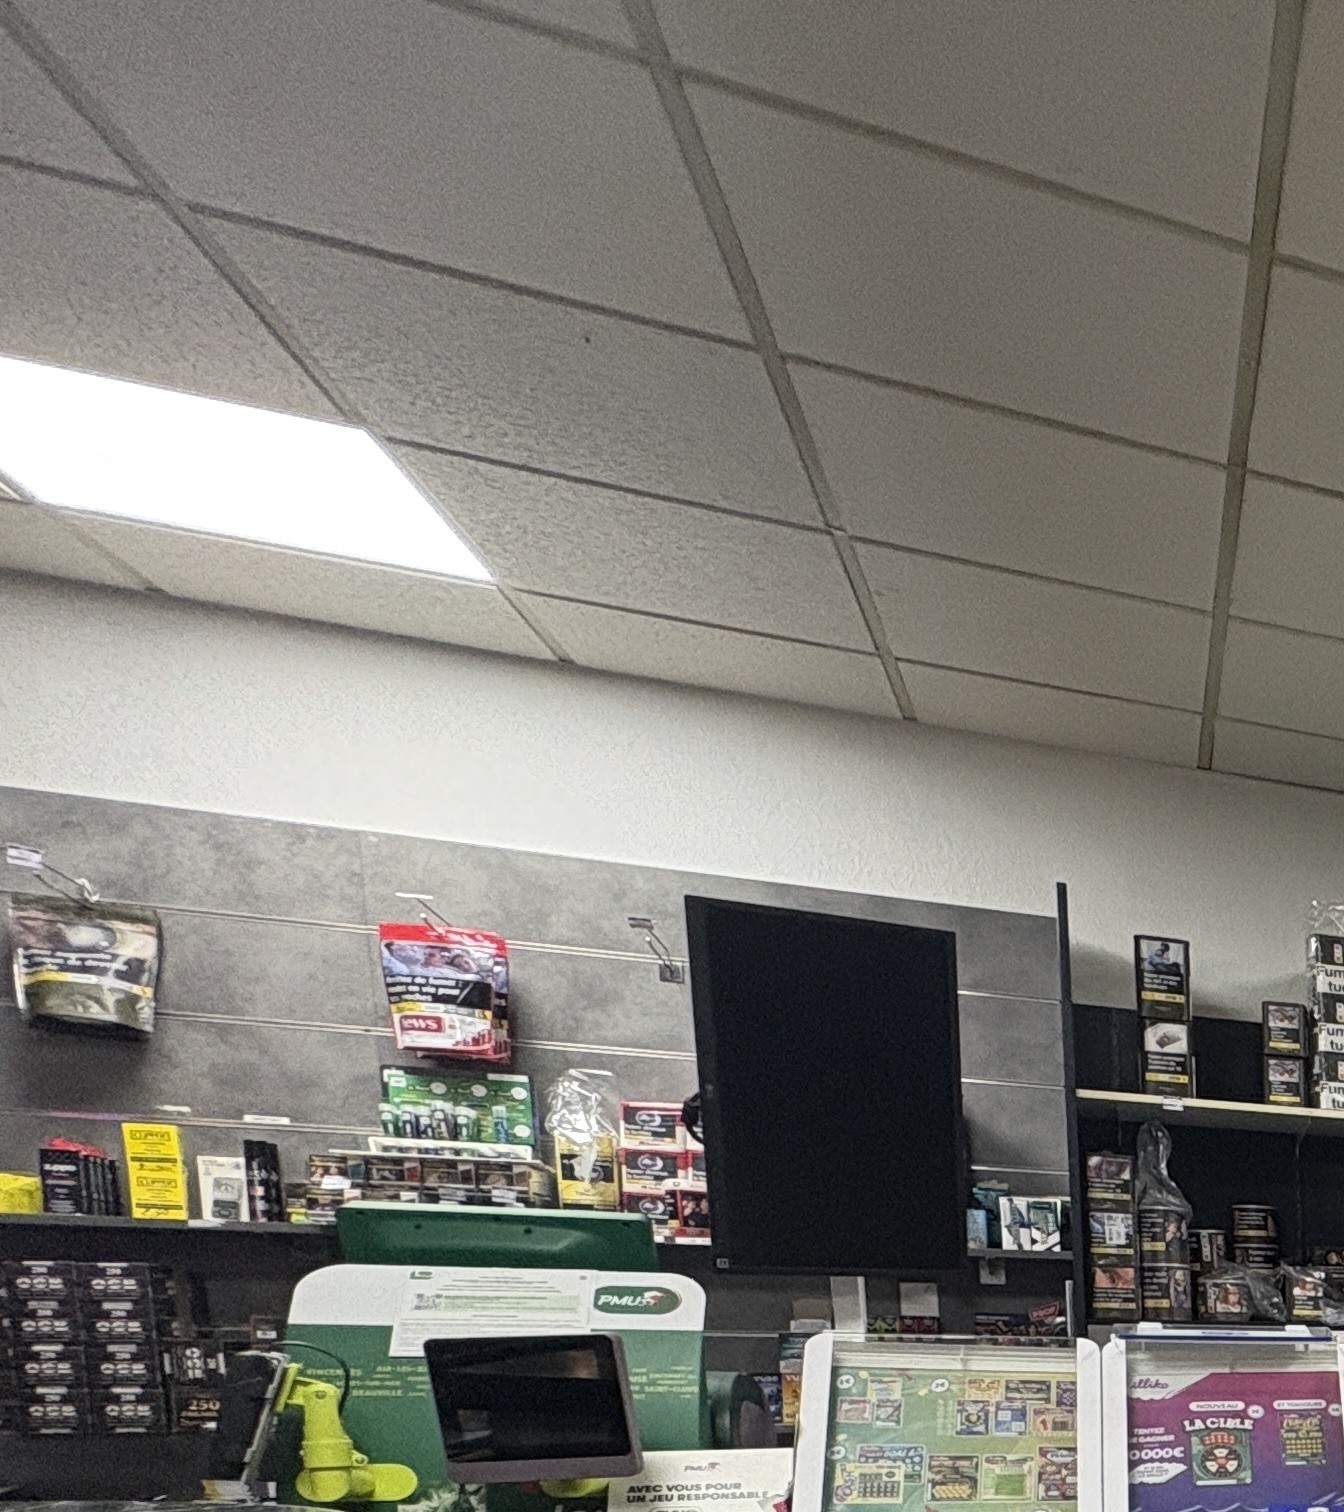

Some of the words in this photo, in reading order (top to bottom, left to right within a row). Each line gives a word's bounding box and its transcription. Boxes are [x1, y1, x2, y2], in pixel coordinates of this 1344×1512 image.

[1184, 1420, 1204, 1431] LA
[1206, 1419, 1254, 1431] CIBLE
[666, 1484, 702, 1492] VOUS
[706, 1483, 741, 1491] POUR
[627, 1495, 645, 1503] UN
[649, 1494, 673, 1502] JEU
